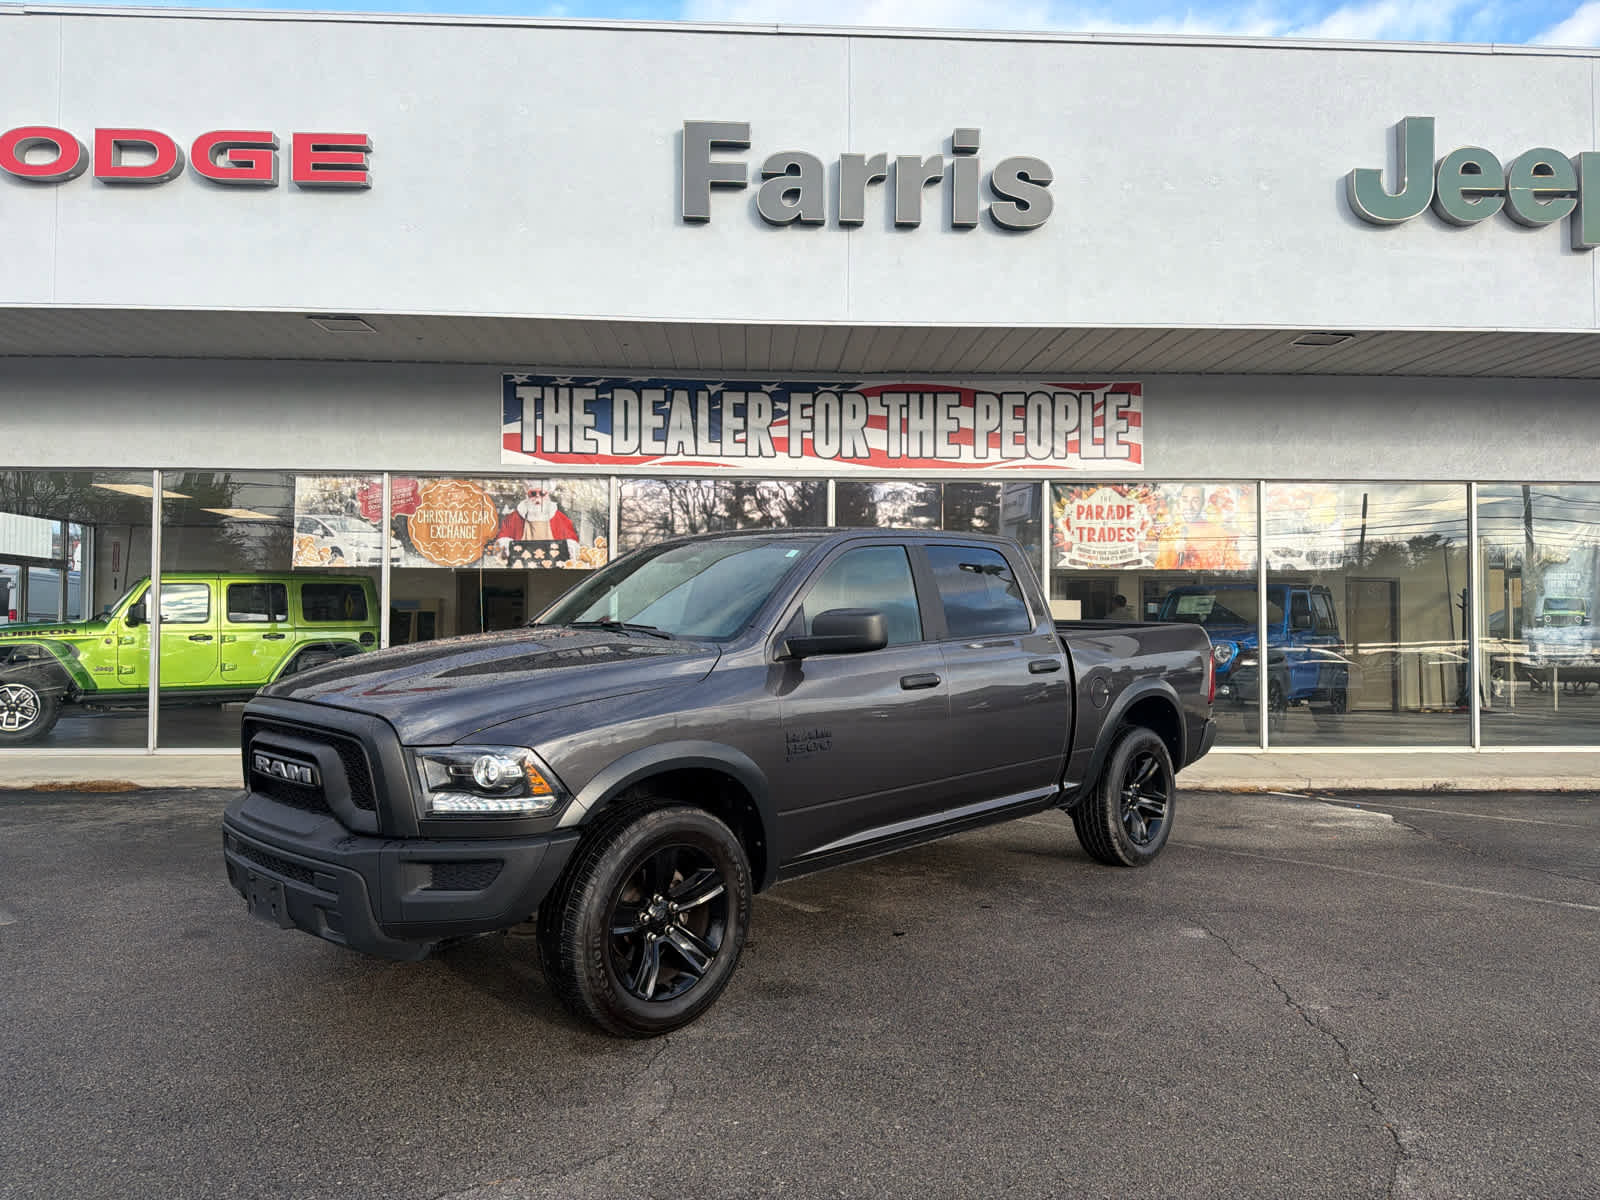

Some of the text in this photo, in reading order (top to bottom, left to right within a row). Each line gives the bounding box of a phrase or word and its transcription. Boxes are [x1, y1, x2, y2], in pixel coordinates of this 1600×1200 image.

[682, 120, 1055, 230] Farris
[516, 385, 1130, 460] THE DEALER FOR THE PEOPLE
[417, 510, 490, 525] CHRISTMAS CAR
[1076, 504, 1135, 520] PARADE
[430, 525, 478, 539] EXCHANGE
[1075, 527, 1136, 542] TRADES
[255, 754, 312, 783] RAM
